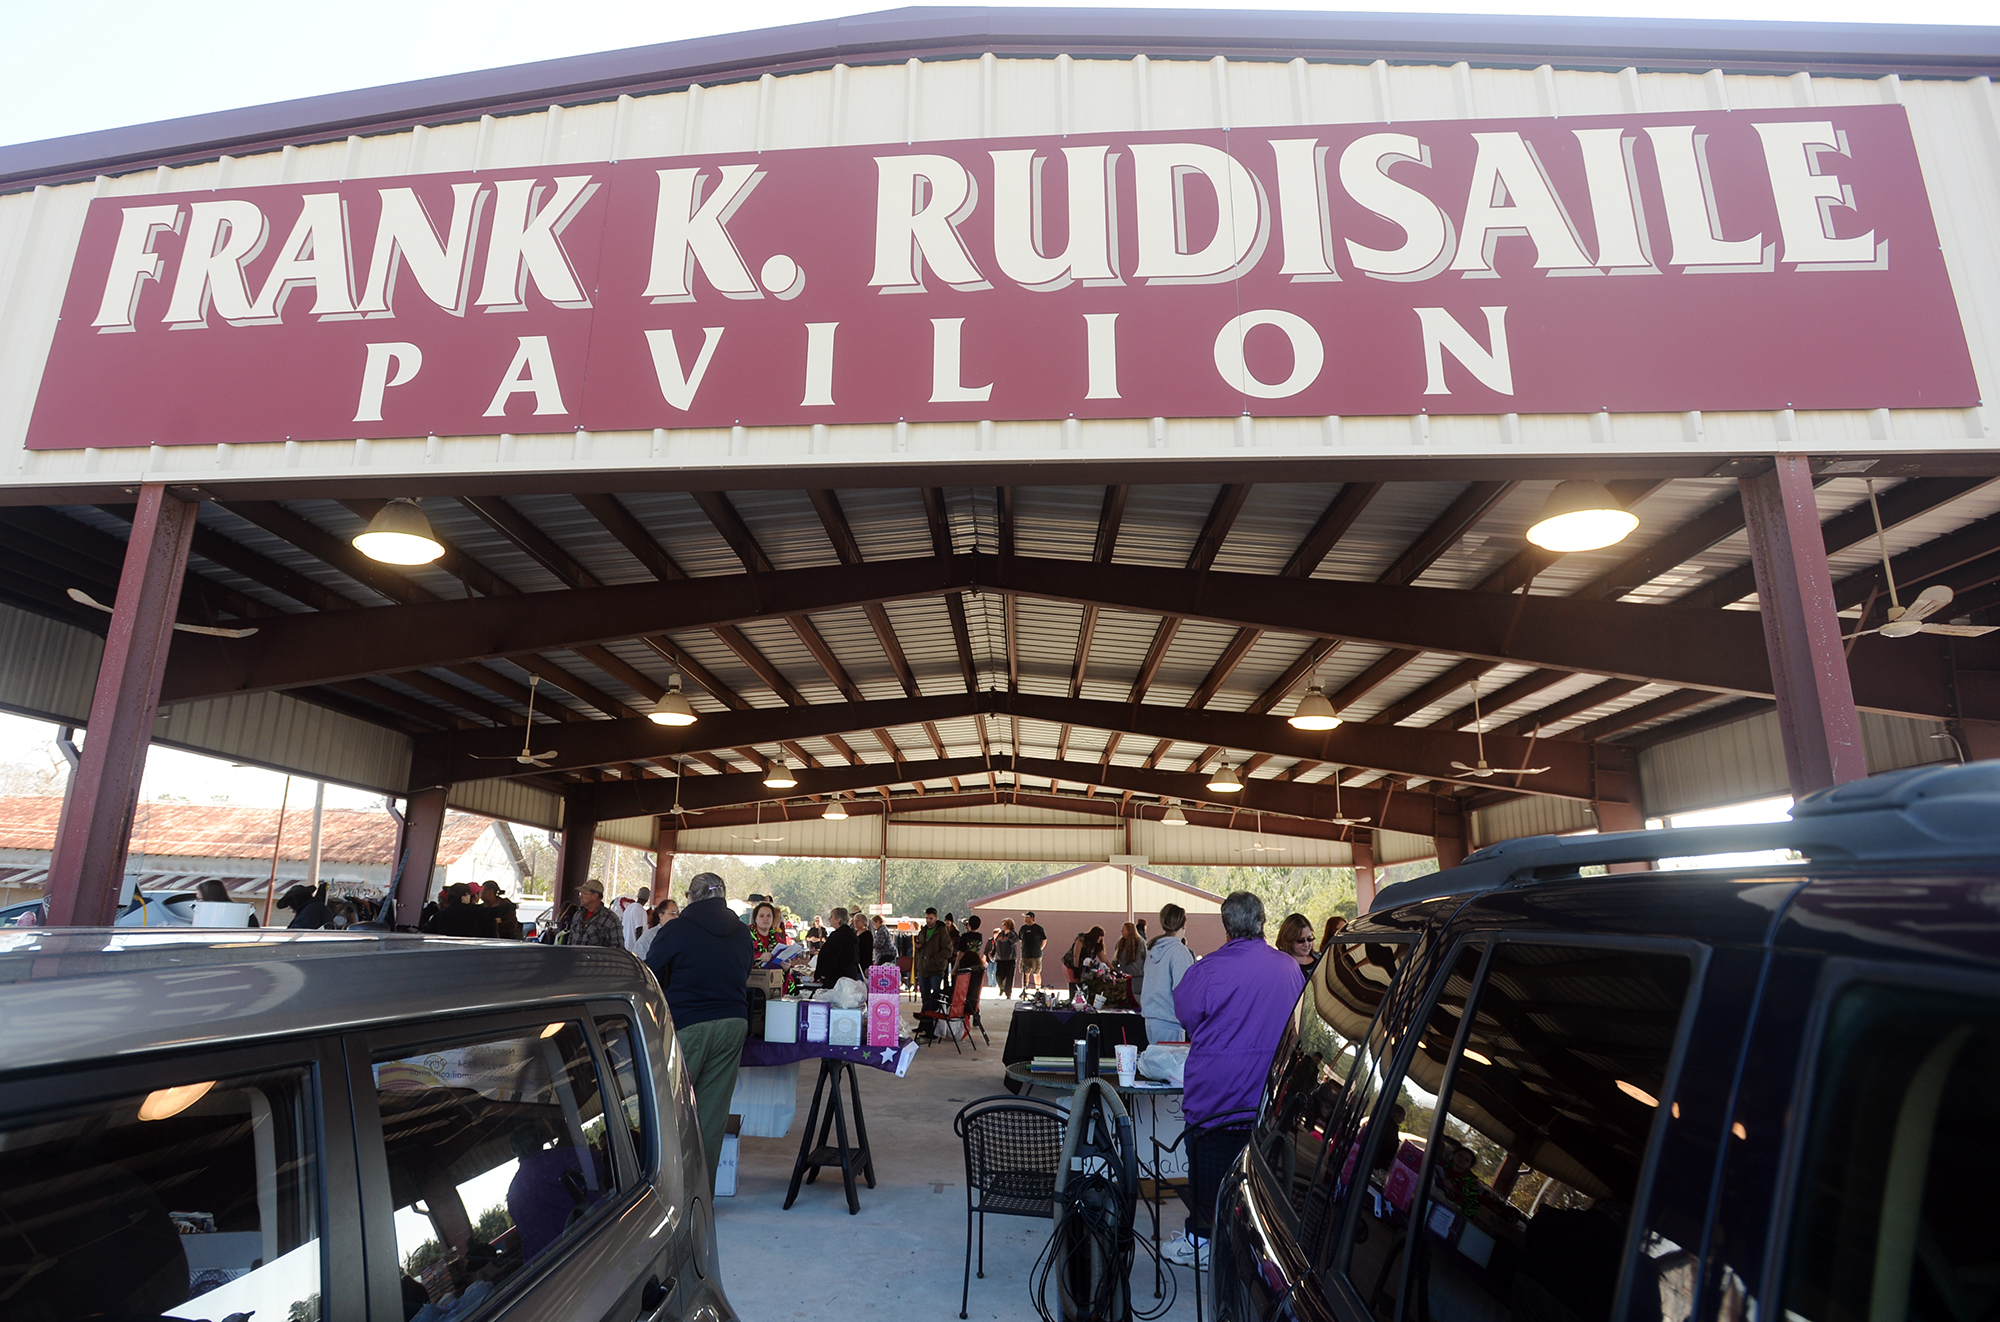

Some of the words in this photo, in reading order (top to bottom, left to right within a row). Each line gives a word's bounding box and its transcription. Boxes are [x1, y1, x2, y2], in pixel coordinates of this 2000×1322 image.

[92, 174, 601, 335] FRANK
[641, 163, 806, 305] K.
[867, 121, 1890, 295] RUDISAILE
[352, 305, 1515, 423] PAVILION
